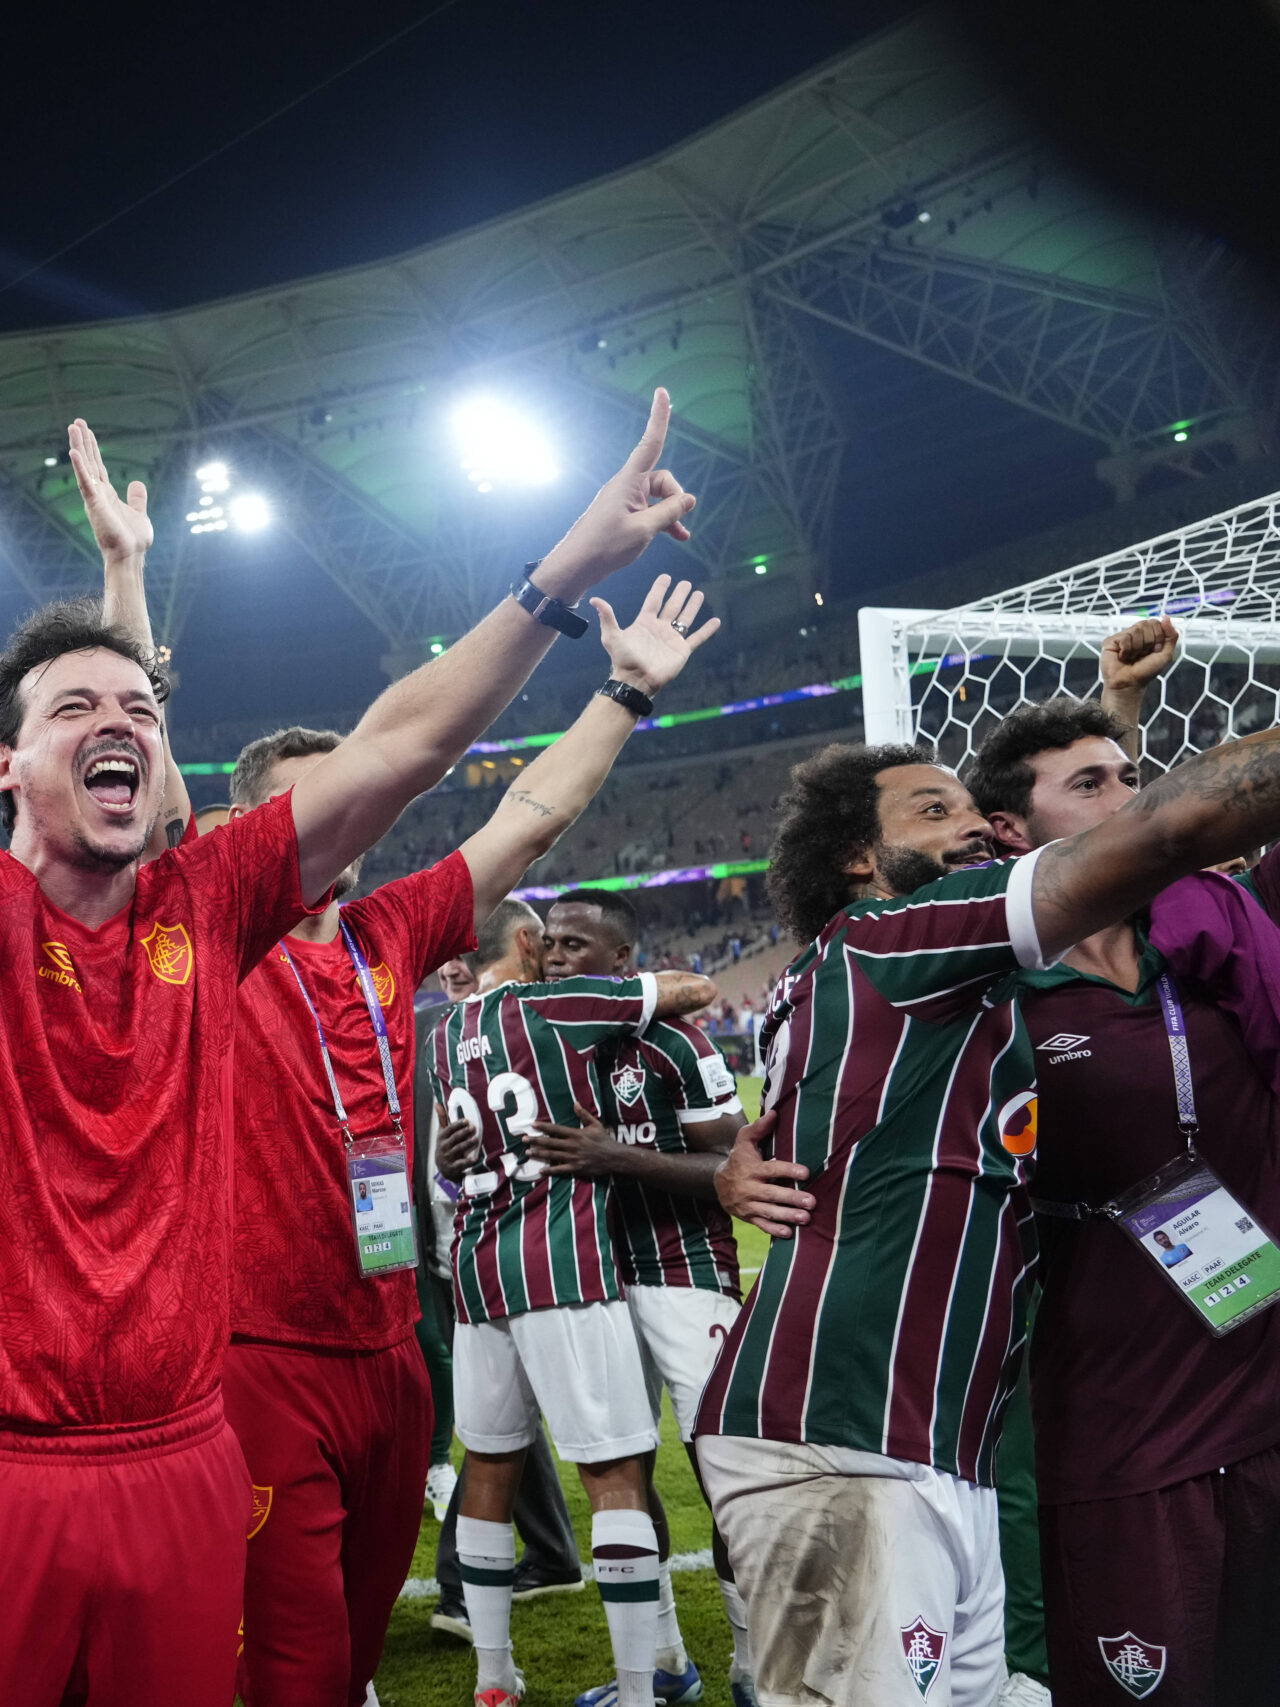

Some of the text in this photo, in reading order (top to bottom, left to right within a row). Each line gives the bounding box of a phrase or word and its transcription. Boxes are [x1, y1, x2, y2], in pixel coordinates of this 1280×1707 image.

[1166, 997, 1177, 1015] CLUB
[1172, 1015, 1180, 1031] FIFA
[456, 1034, 493, 1065] GUGA
[1049, 1049, 1092, 1065] umbro
[1173, 1209, 1201, 1230] AGUILAR
[1178, 1221, 1200, 1237] Alvaro
[1182, 1273, 1201, 1287] KASC
[1204, 1259, 1222, 1273] PAAF
[1204, 1251, 1262, 1290] TEAM DELEGATE
[1209, 1276, 1246, 1304] 1 2 4
[598, 1565, 635, 1574] FFC
